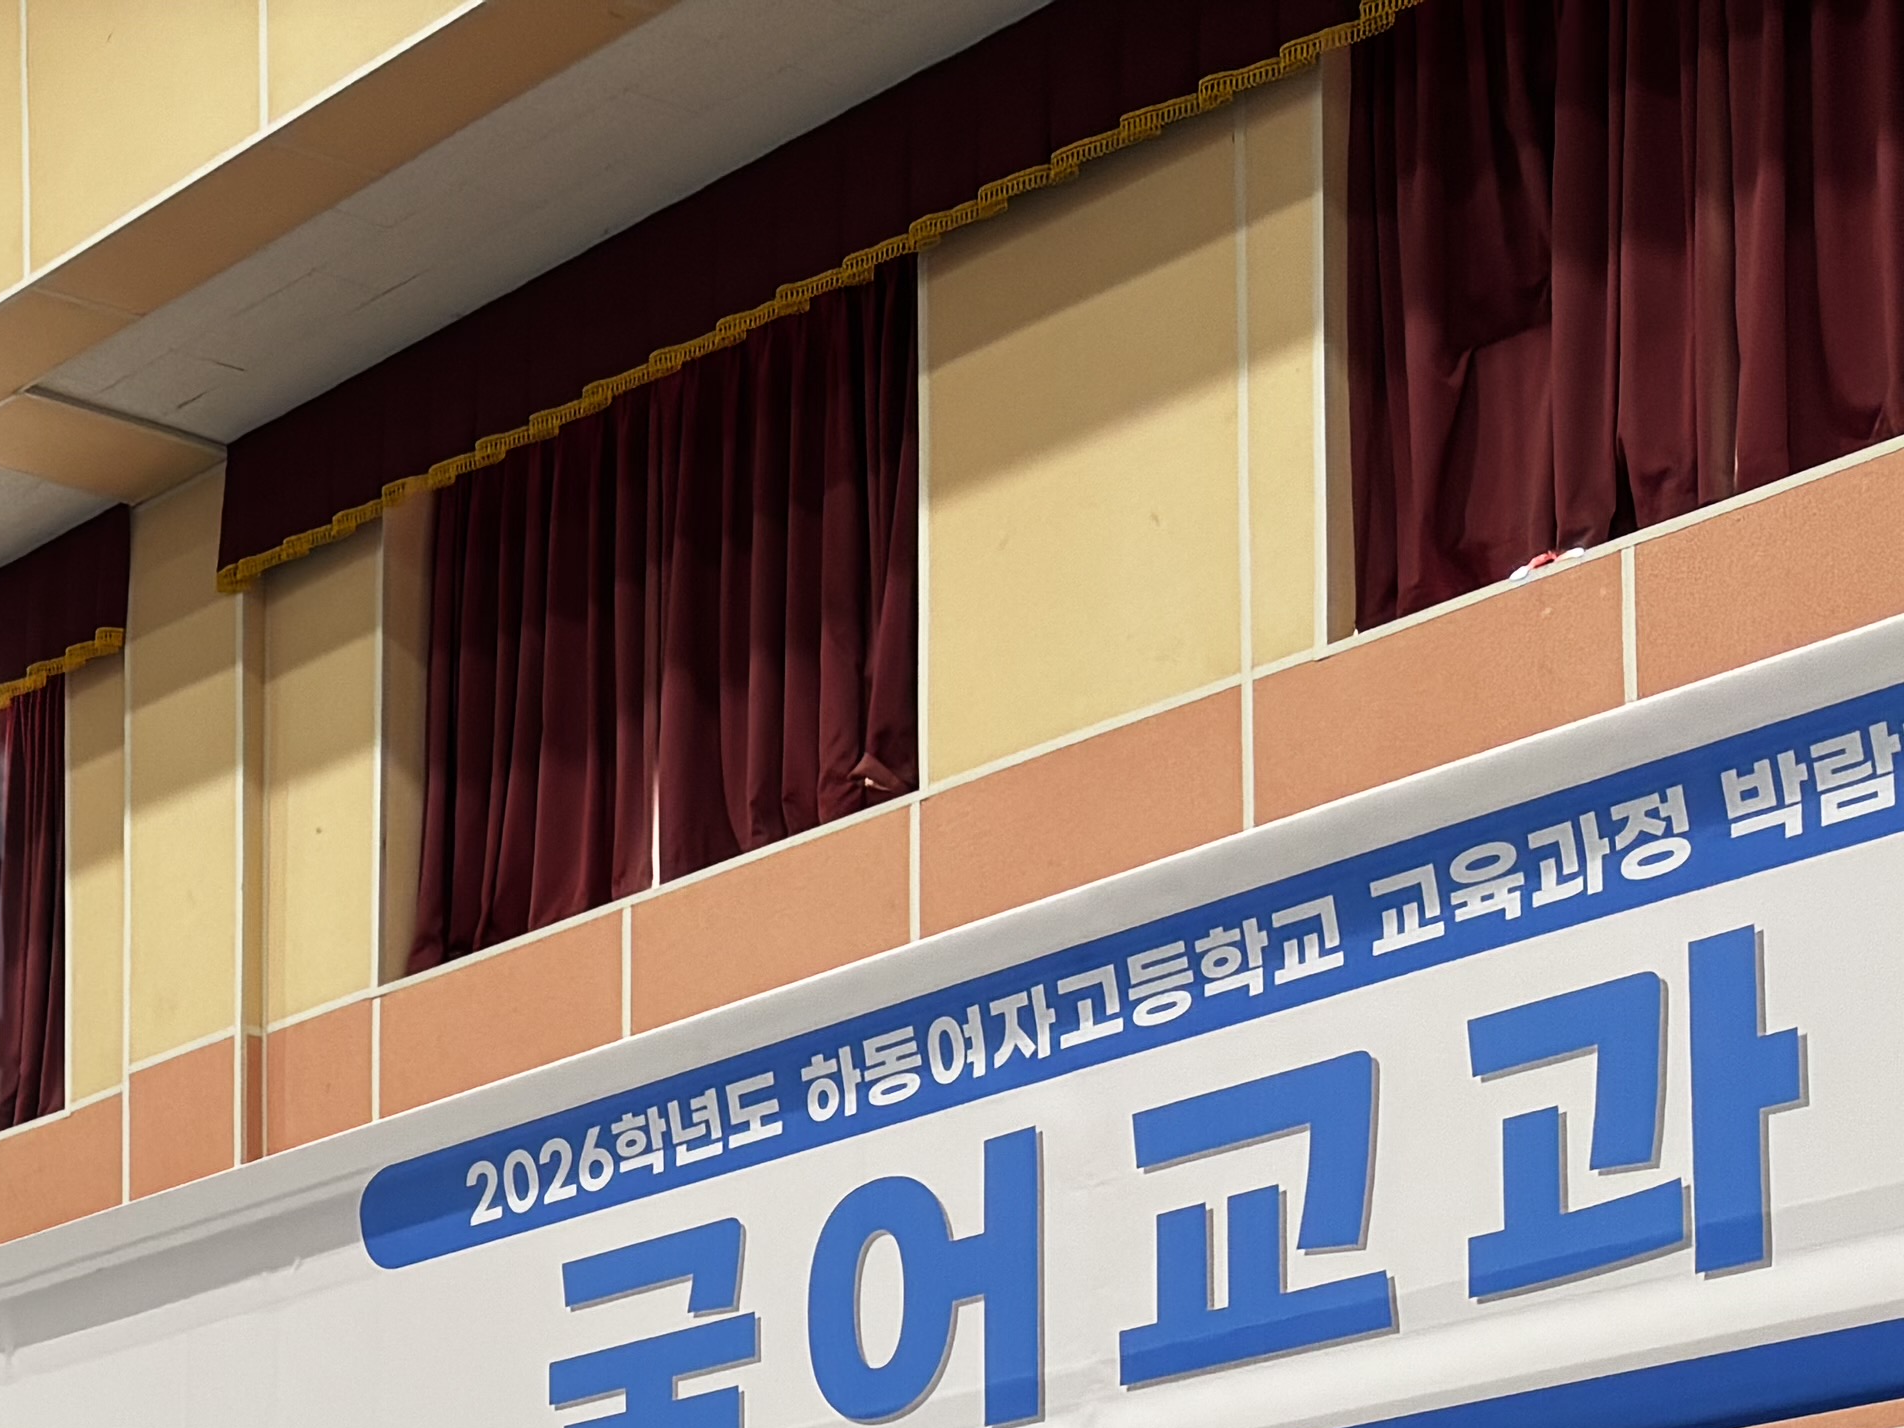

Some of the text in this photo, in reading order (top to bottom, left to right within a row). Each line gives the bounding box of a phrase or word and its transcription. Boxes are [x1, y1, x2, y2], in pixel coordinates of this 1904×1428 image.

[466, 720, 1904, 1228] 2026학년도 하동여자고등학교 교육과정 박람
